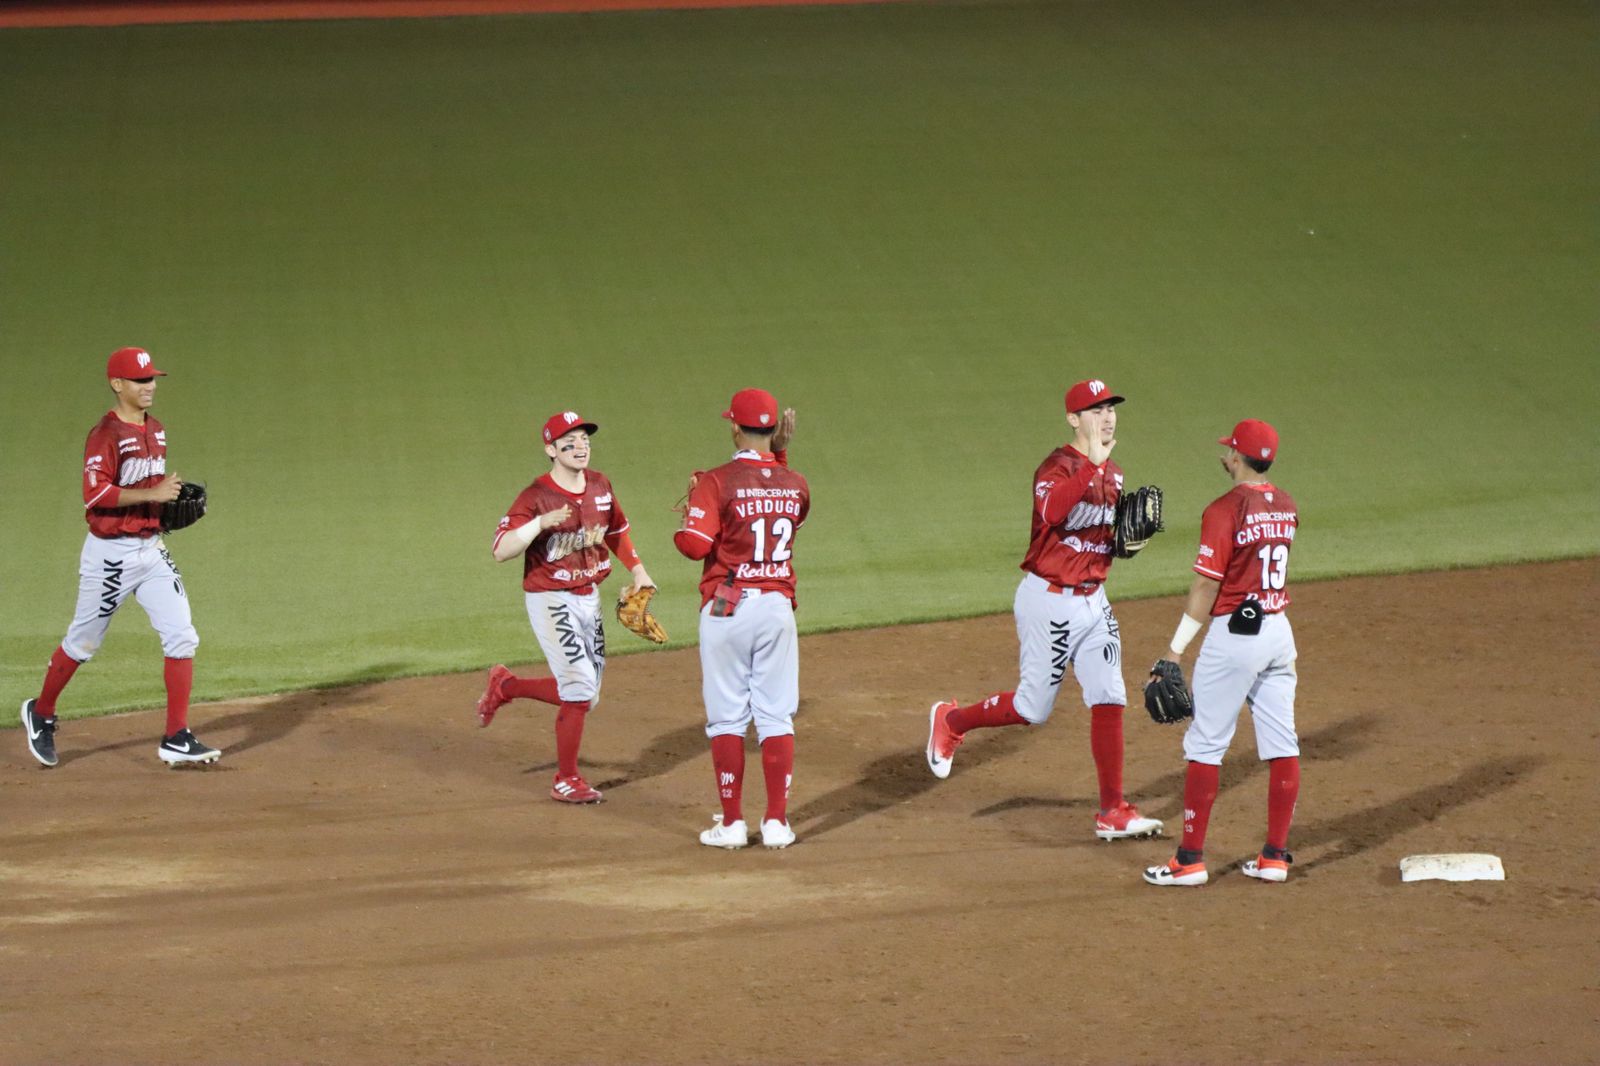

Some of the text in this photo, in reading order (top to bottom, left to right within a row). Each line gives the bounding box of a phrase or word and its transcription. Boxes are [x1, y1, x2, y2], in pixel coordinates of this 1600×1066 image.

[736, 499, 800, 518] VERDUGO
[751, 517, 793, 562] 12
[98, 559, 123, 617] KAVAK
[735, 563, 765, 578] Red
[1258, 544, 1289, 590] 13
[547, 603, 585, 665] KAVAK
[1049, 620, 1071, 687] KAVAK
